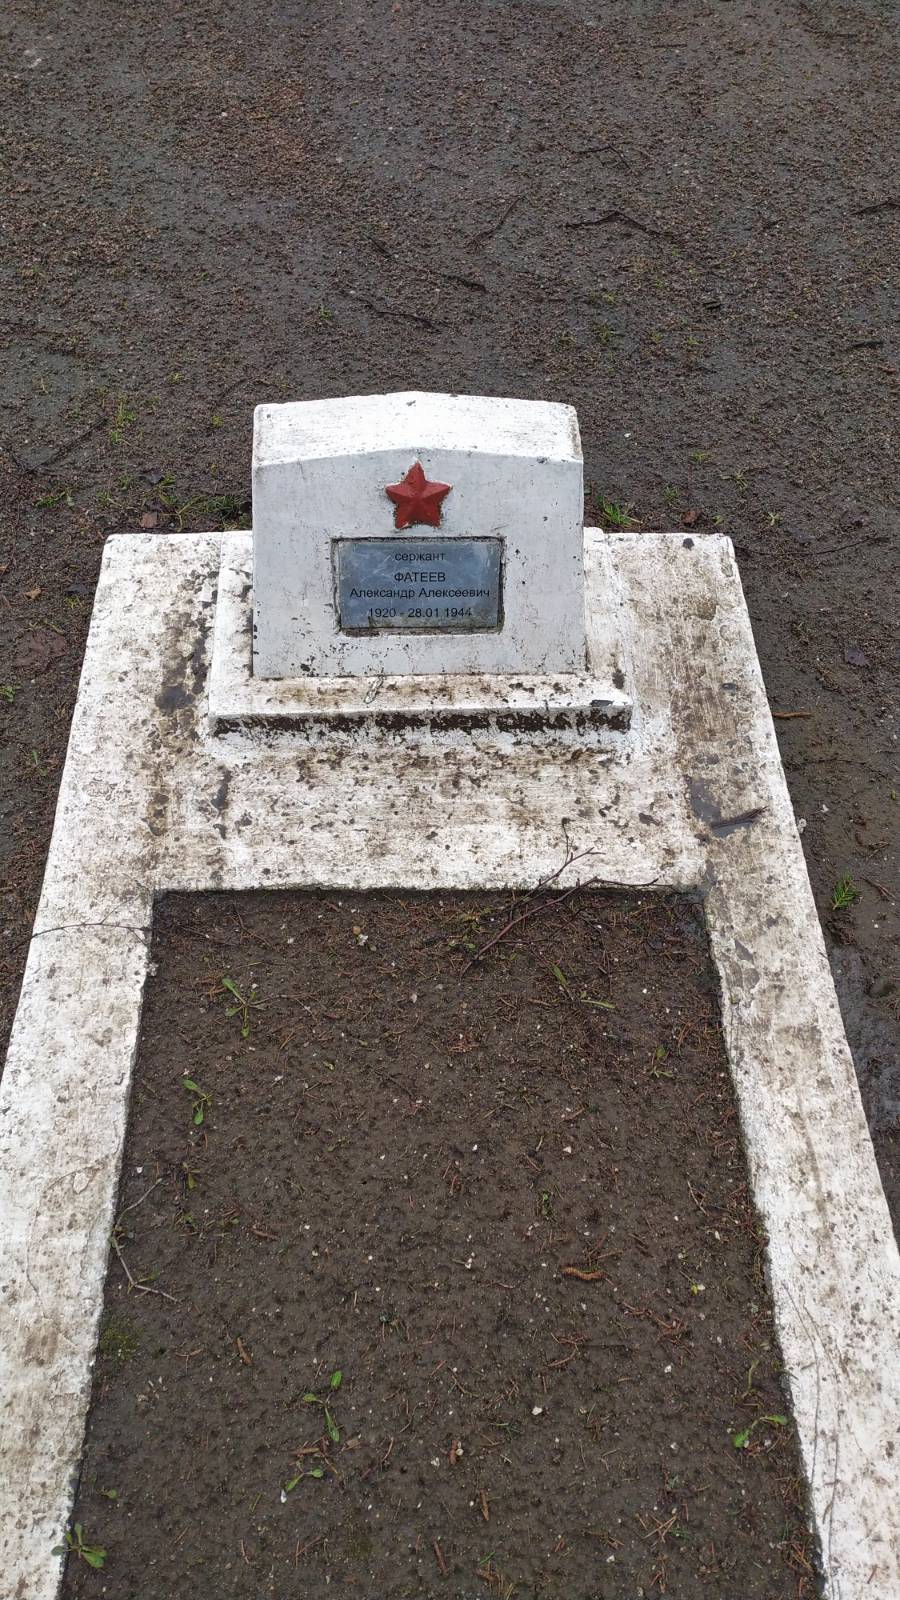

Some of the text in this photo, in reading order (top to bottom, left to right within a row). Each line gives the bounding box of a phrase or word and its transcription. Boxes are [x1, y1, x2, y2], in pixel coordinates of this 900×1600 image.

[394, 552, 446, 562] сержант
[394, 572, 446, 583] ФАТЕЕВ
[350, 588, 490, 599] Александр Алексеевич
[369, 608, 396, 618] 1920
[407, 608, 472, 618] 28.011944
